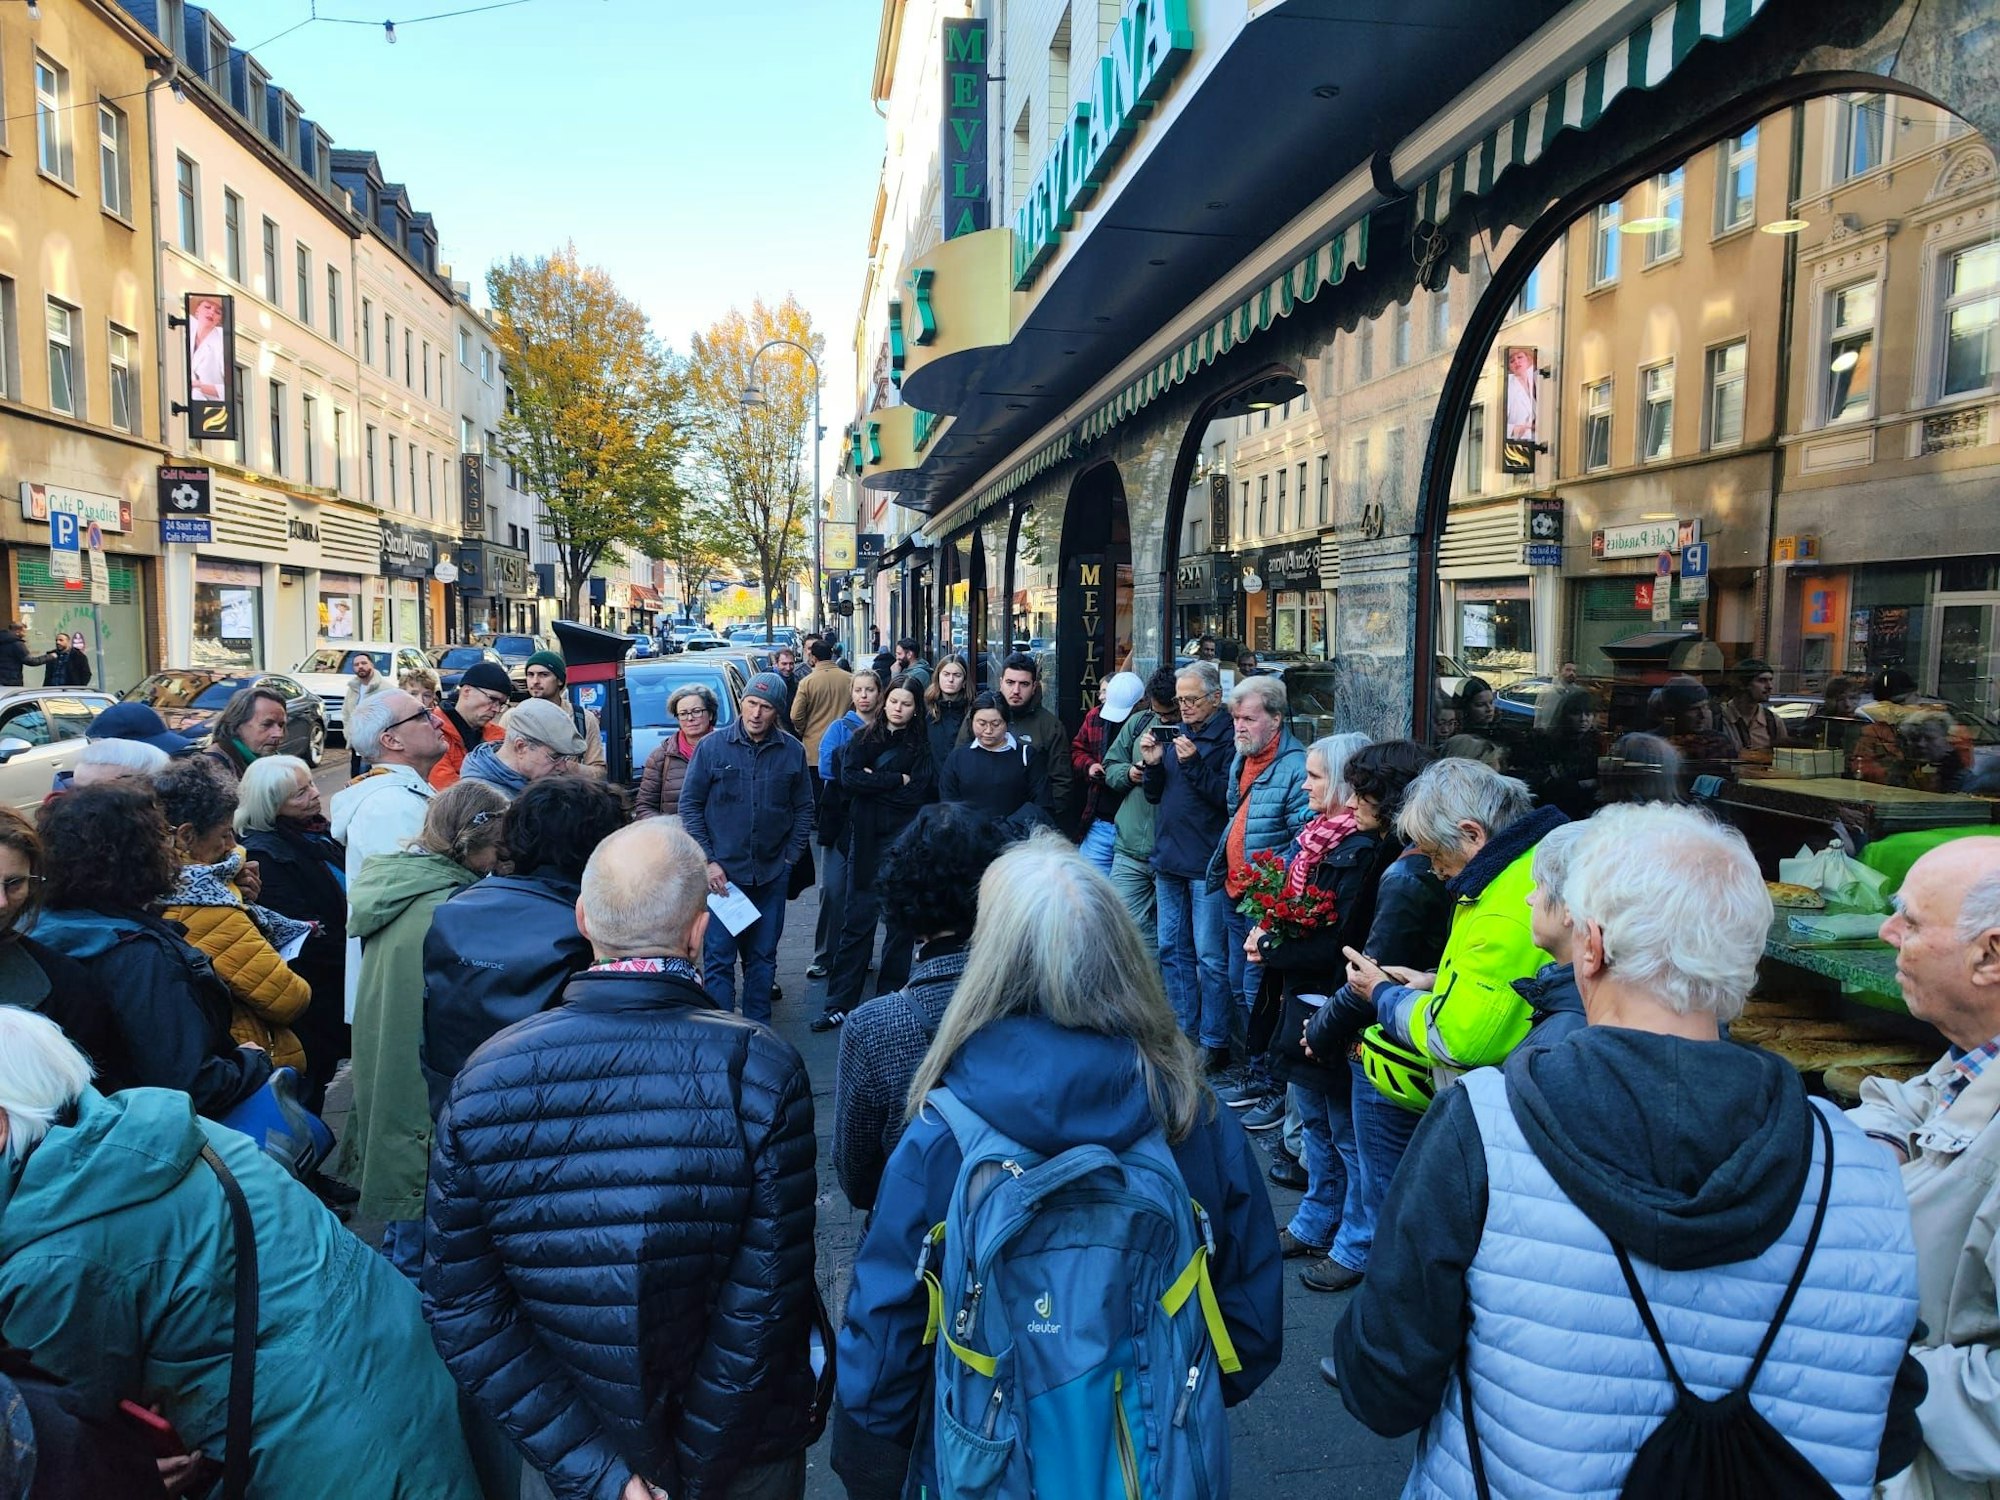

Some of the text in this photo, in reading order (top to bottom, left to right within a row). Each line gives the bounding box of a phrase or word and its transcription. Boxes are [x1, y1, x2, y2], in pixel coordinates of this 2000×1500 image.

[468, 469, 480, 522] AKSU
[58, 514, 74, 545] P
[1360, 502, 1382, 538] 49
[1027, 1319, 1062, 1334] deuter
